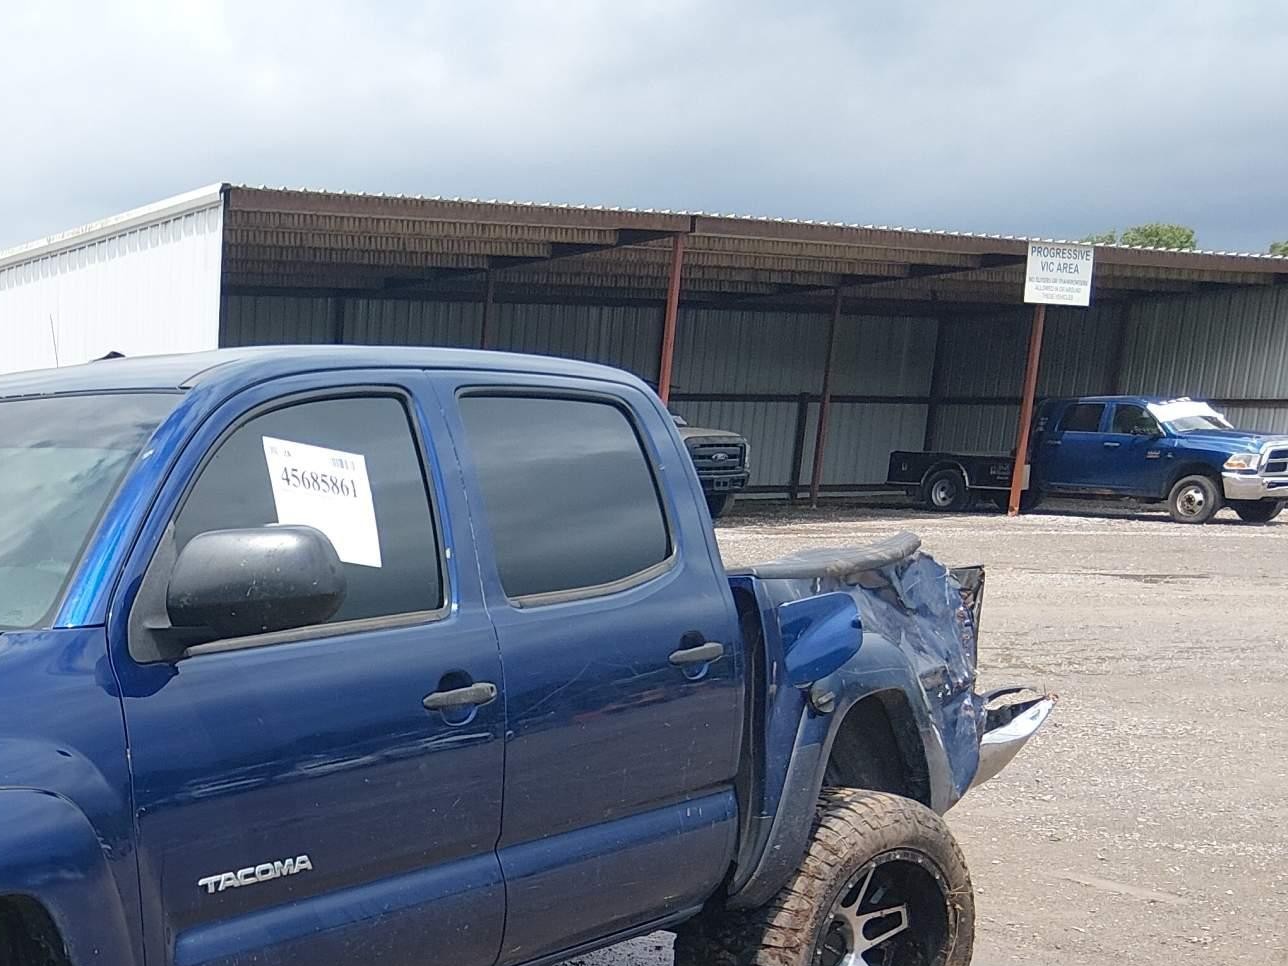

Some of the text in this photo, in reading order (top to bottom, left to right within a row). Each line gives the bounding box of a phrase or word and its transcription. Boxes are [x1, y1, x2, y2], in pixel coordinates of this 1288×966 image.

[1031, 246, 1091, 261] PROGRESSIVE
[1040, 261, 1080, 274] VIC AREA
[280, 466, 358, 498] 45685861
[198, 855, 313, 893] TACOMA
